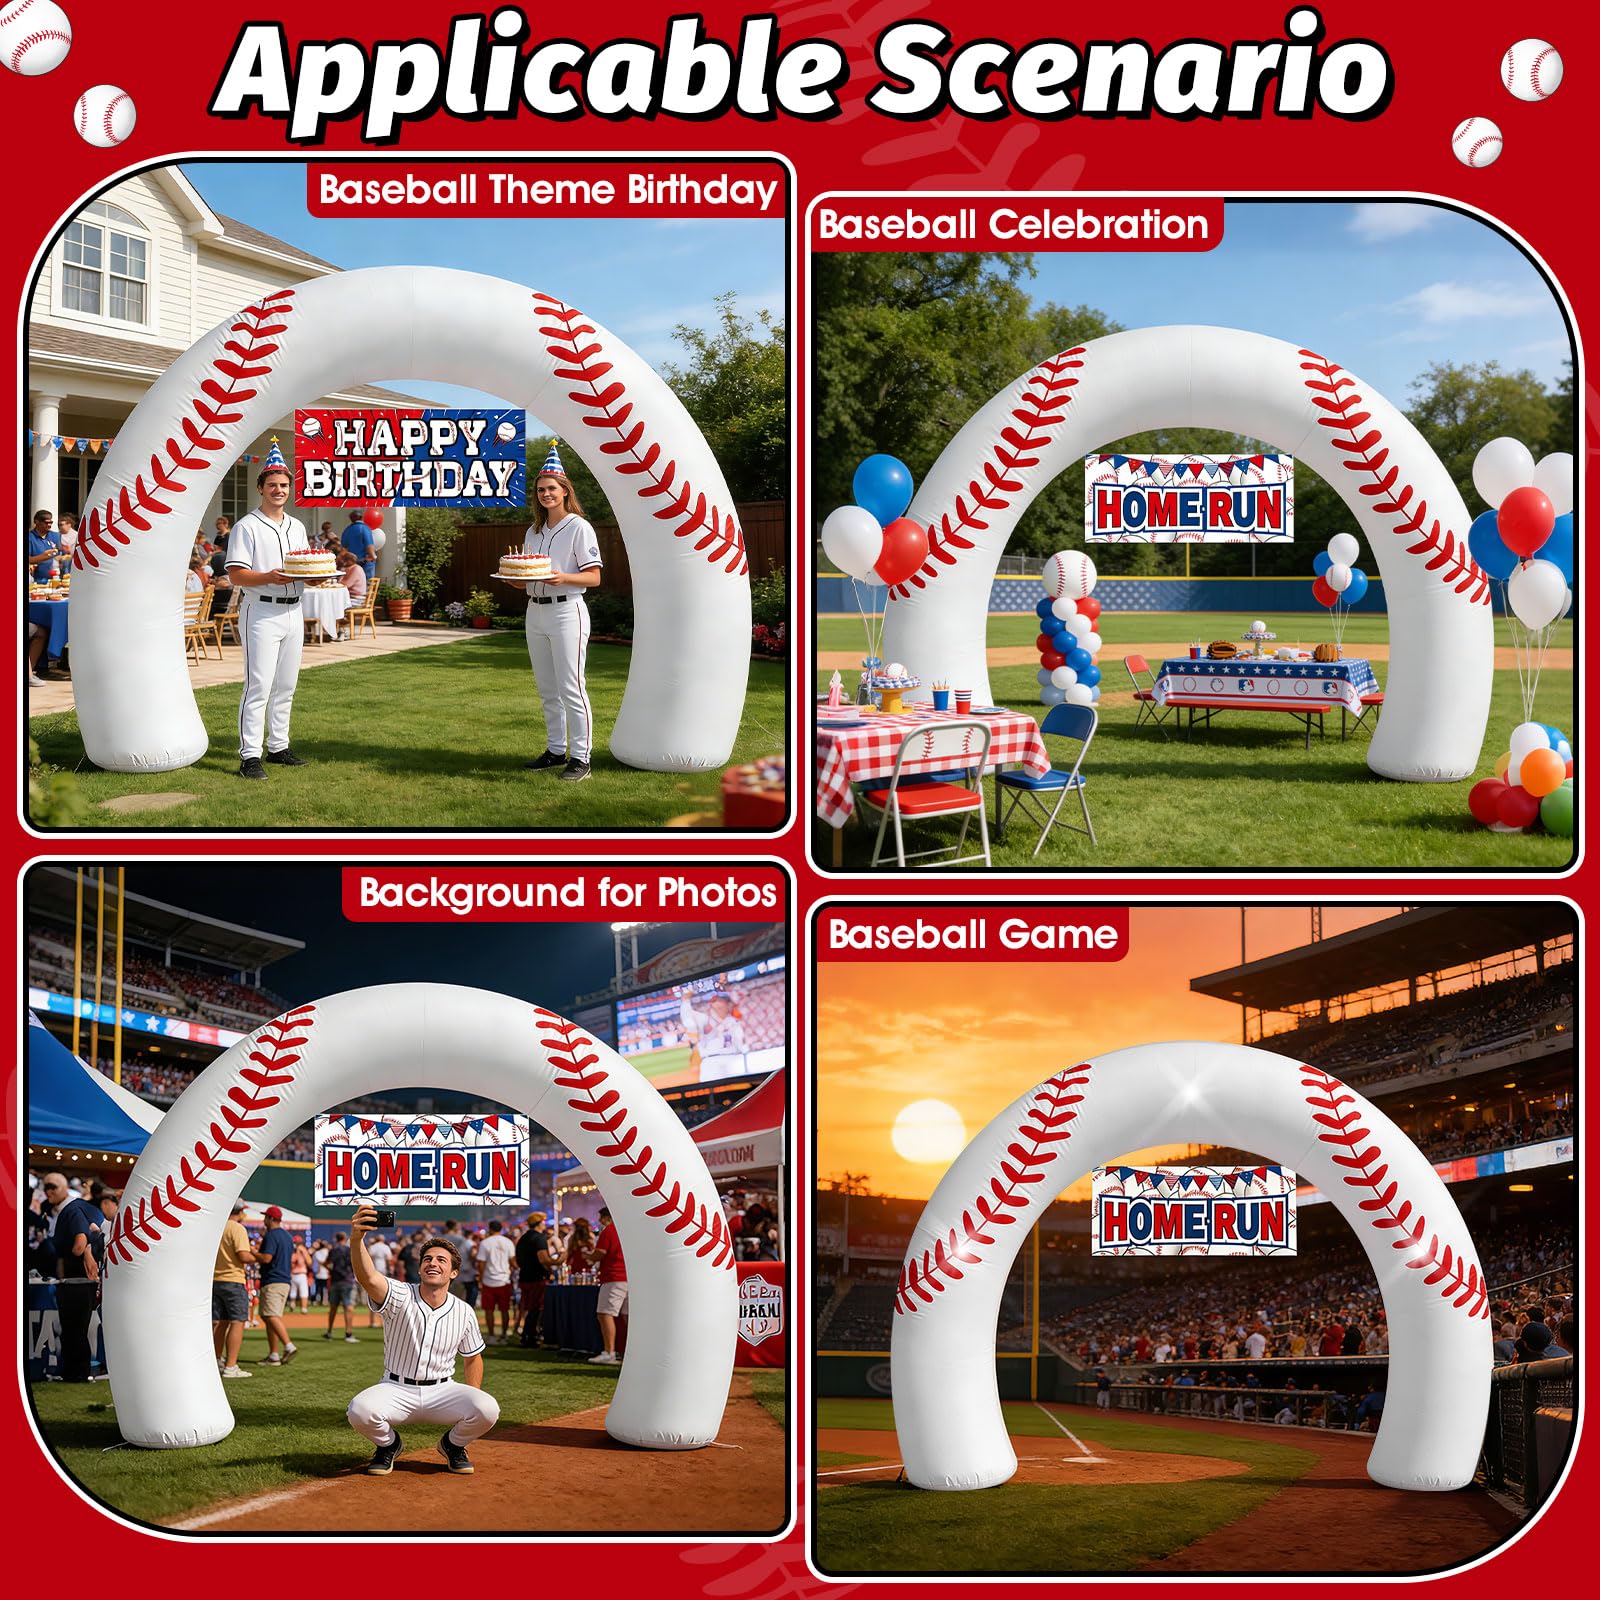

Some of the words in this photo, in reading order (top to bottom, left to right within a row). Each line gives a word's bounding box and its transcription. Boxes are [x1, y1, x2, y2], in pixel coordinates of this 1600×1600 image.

[334, 418, 487, 456] HAPPY
[303, 460, 517, 498] BIRTHDAY
[1097, 489, 1200, 530] HOME
[1209, 489, 1282, 529] RUN
[327, 1150, 433, 1192] HOME
[442, 1150, 517, 1192] RUN
[1104, 1200, 1205, 1243] HOME
[1213, 1200, 1284, 1243] RUN
